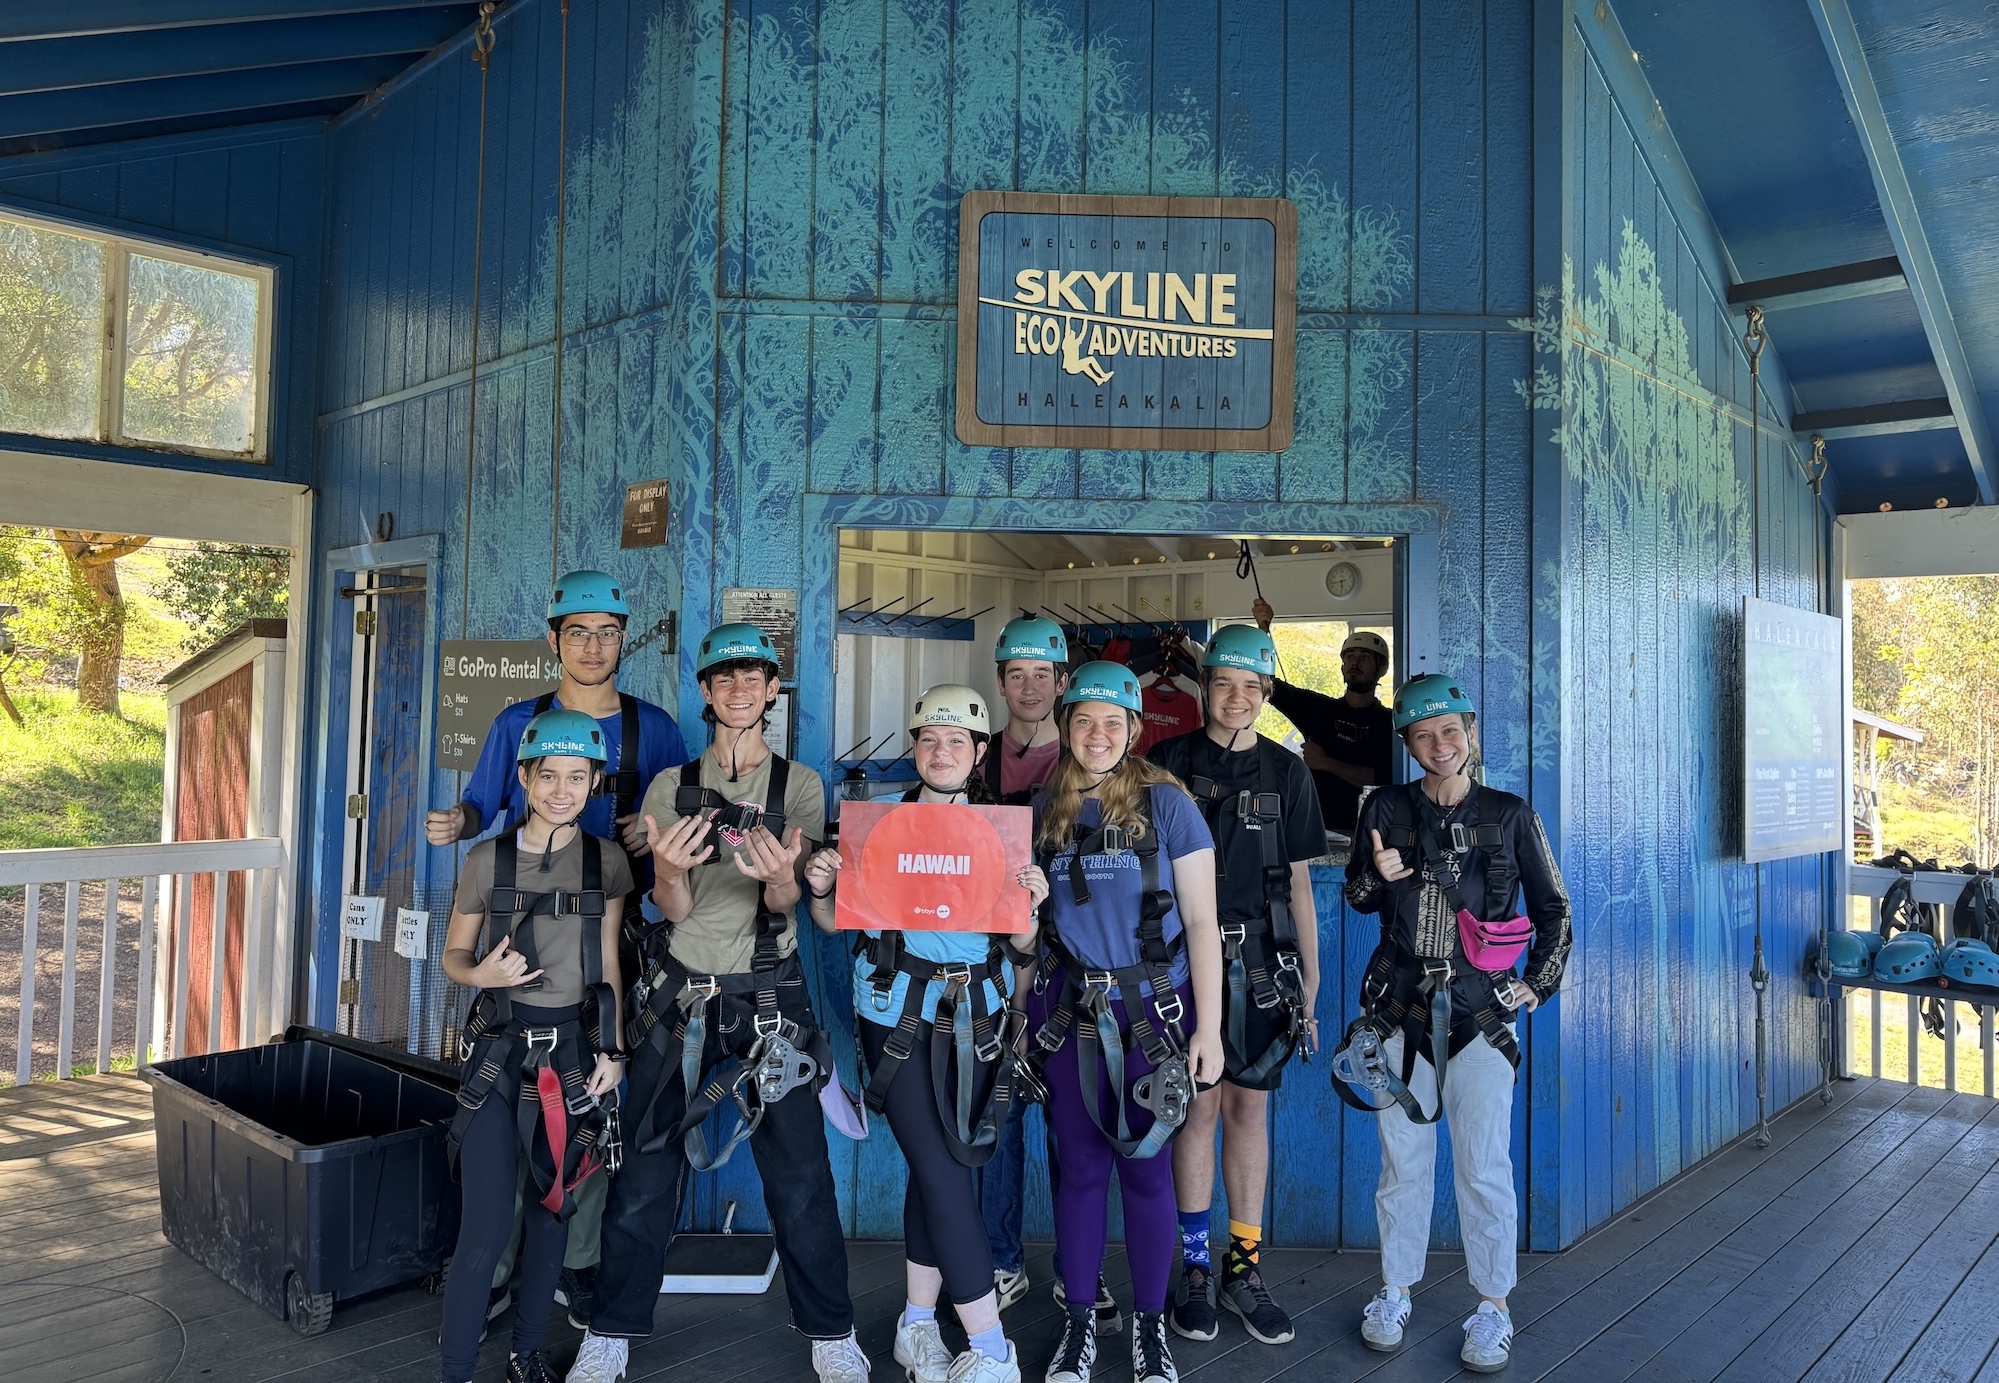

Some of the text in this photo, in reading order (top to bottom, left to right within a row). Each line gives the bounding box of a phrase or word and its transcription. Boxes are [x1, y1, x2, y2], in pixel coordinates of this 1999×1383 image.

[1021, 237, 1231, 253] WELCOME TO
[1014, 268, 1237, 326] SKYLINE
[1015, 312, 1238, 358] ECO ADVENTURES
[1018, 392, 1232, 411] HALEAKALA
[630, 485, 668, 502] FOR DISPLAY
[639, 501, 655, 514] ONLY
[1010, 646, 1046, 656] SKYLINE
[1220, 654, 1256, 666] SKYLINE
[458, 656, 497, 678] GoPro
[500, 656, 540, 680] Rental
[455, 693, 468, 704] Hats
[1080, 687, 1118, 698] SKYLINE
[455, 707, 464, 716] $25
[924, 714, 962, 723] SKYLINE
[1144, 712, 1180, 726] SKYLINE
[454, 732, 476, 746] T-Shirts
[454, 747, 462, 757] $30
[542, 741, 585, 752] SKYLINE
[898, 853, 971, 876] HAWAII
[350, 902, 366, 912] Cans
